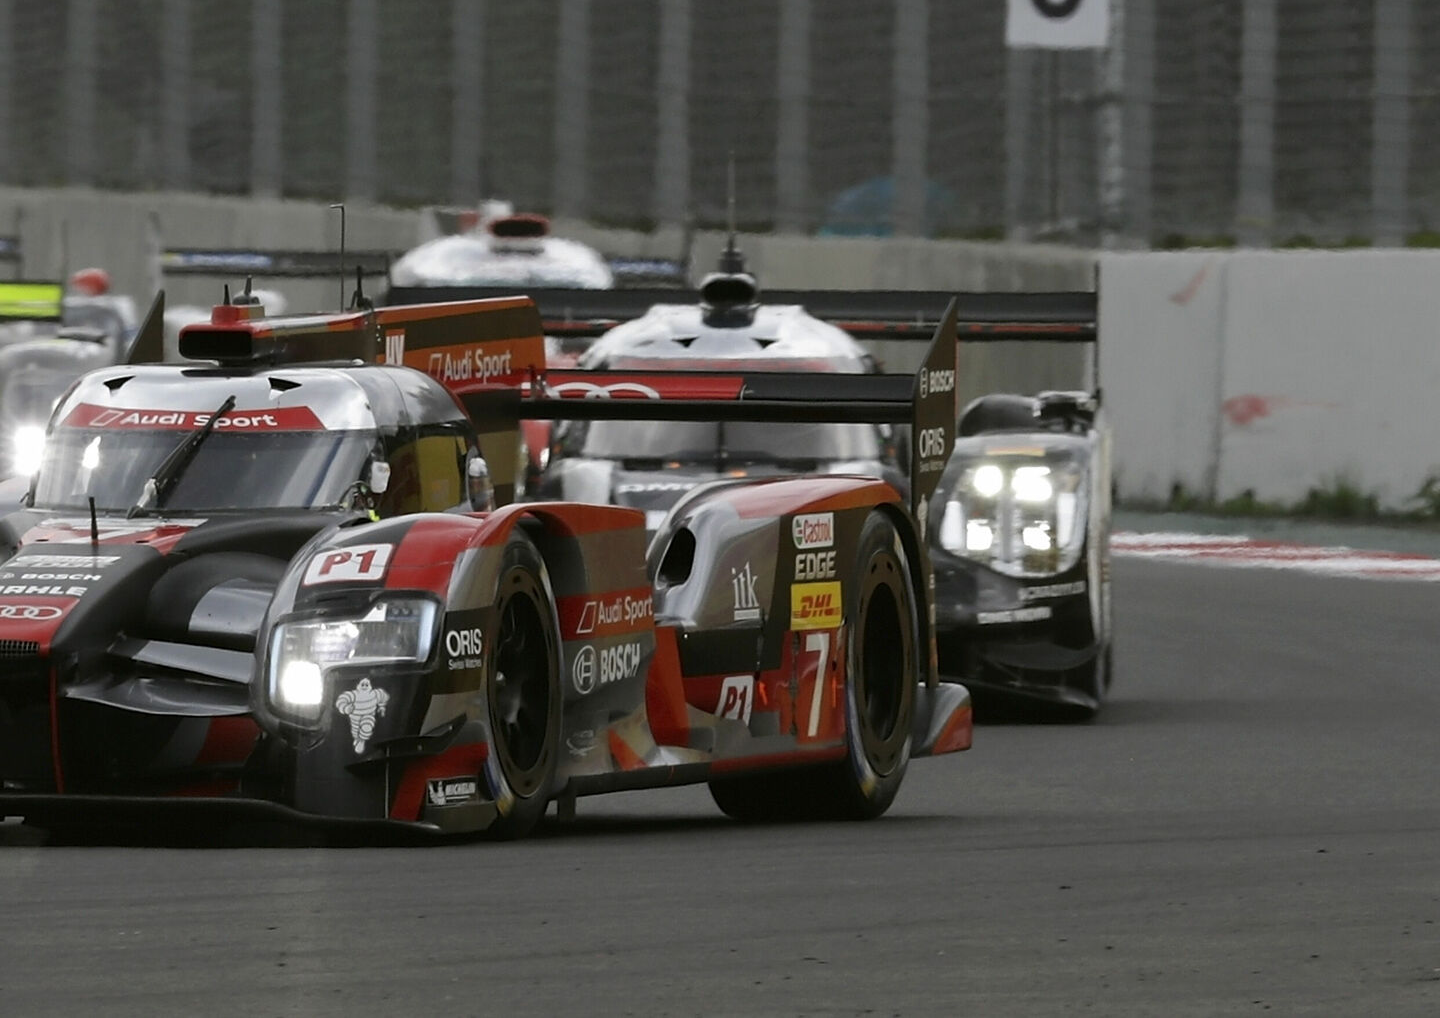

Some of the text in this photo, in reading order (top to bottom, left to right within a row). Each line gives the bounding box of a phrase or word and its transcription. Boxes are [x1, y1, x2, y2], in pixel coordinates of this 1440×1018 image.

[444, 348, 512, 385] Audi Sport
[120, 412, 278, 429] Audi Sport
[919, 427, 945, 458] ORIS
[803, 517, 832, 544] Castrol
[20, 573, 102, 581] BOSCH
[318, 549, 378, 576] P1
[794, 550, 837, 580] EDGE
[732, 561, 760, 609] itk
[598, 595, 653, 625] Audi Sport
[799, 593, 835, 619] DHL
[445, 628, 483, 657] ORIS
[600, 643, 641, 684] BOSCH
[805, 633, 830, 737] 7
[721, 685, 748, 719] P1
